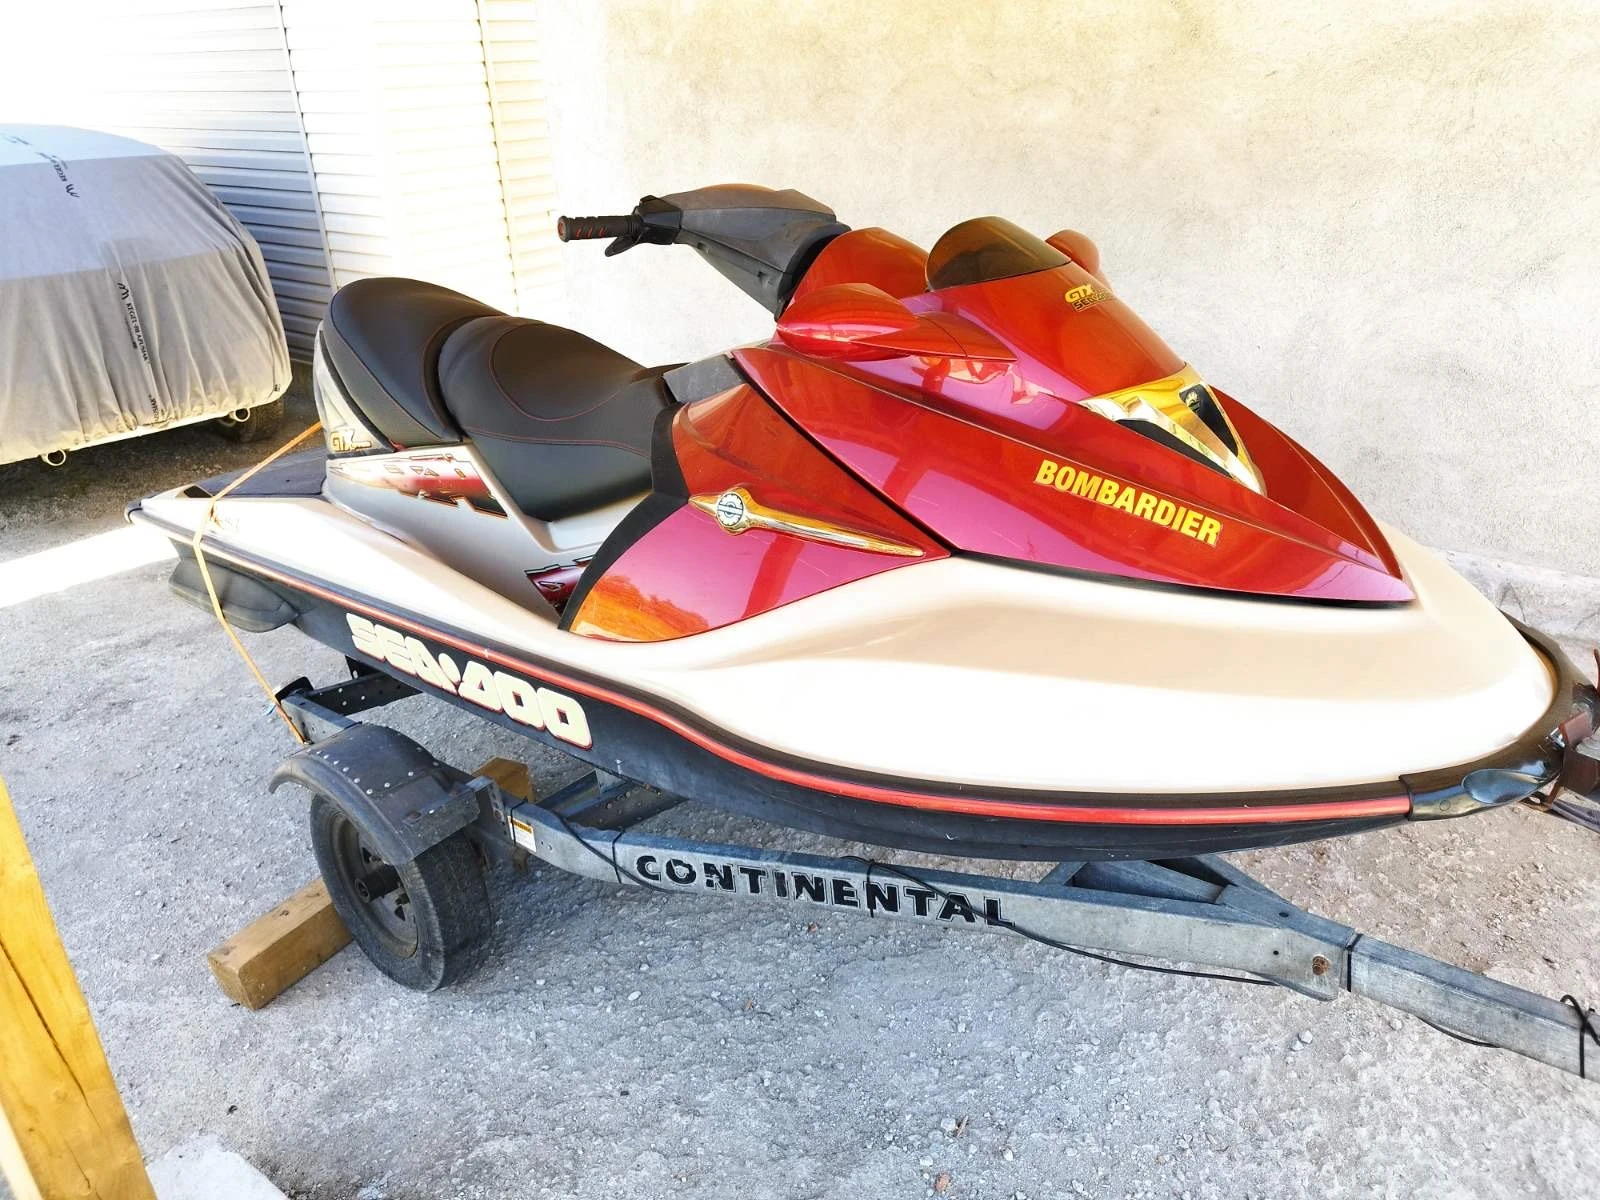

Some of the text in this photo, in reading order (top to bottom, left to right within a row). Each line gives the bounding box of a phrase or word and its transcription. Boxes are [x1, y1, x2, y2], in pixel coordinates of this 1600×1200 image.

[1065, 284, 1093, 303] GTX
[1034, 458, 1223, 547] BOMBARDIER
[636, 854, 1015, 927] CONTINENTAL
